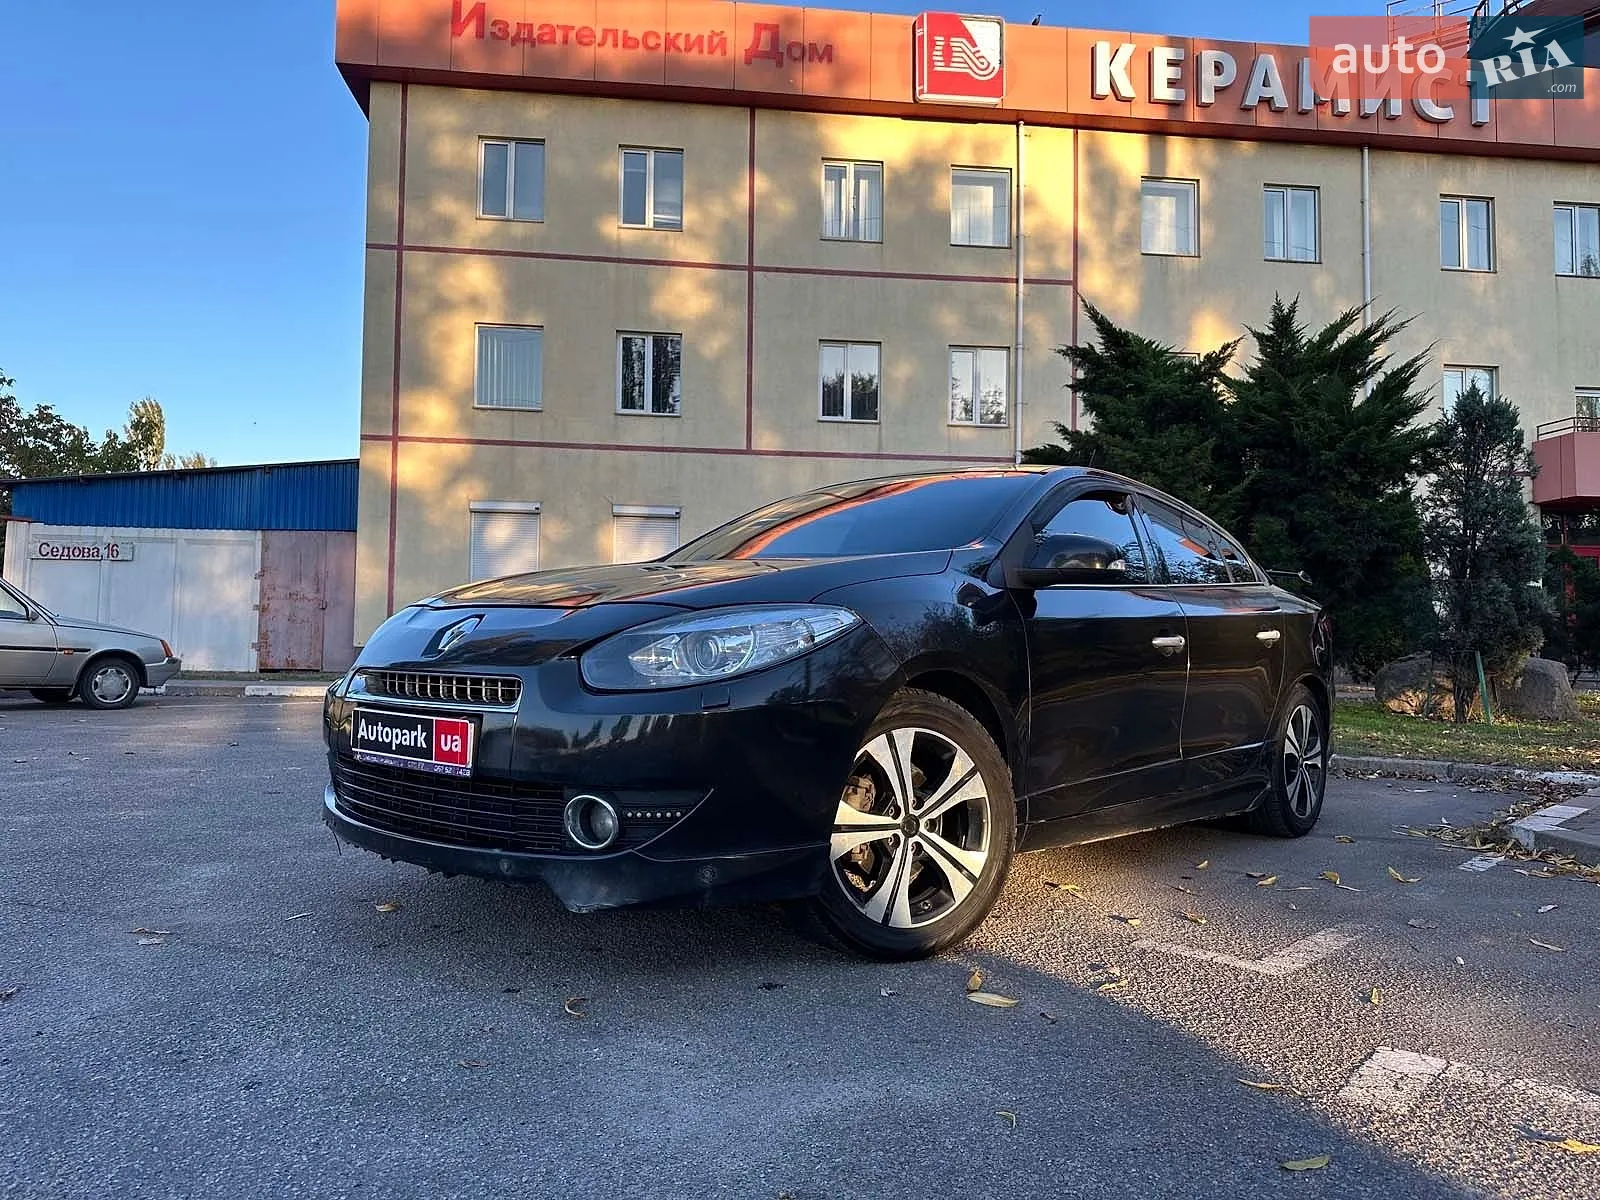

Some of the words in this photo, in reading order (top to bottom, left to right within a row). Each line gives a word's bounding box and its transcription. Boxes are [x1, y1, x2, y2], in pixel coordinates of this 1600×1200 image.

[451, 0, 728, 57] Издательский
[743, 22, 834, 68] Дом
[1091, 40, 1489, 127] КЕРАМИСТ
[358, 718, 427, 751] Autopark
[440, 733, 462, 753] ua
